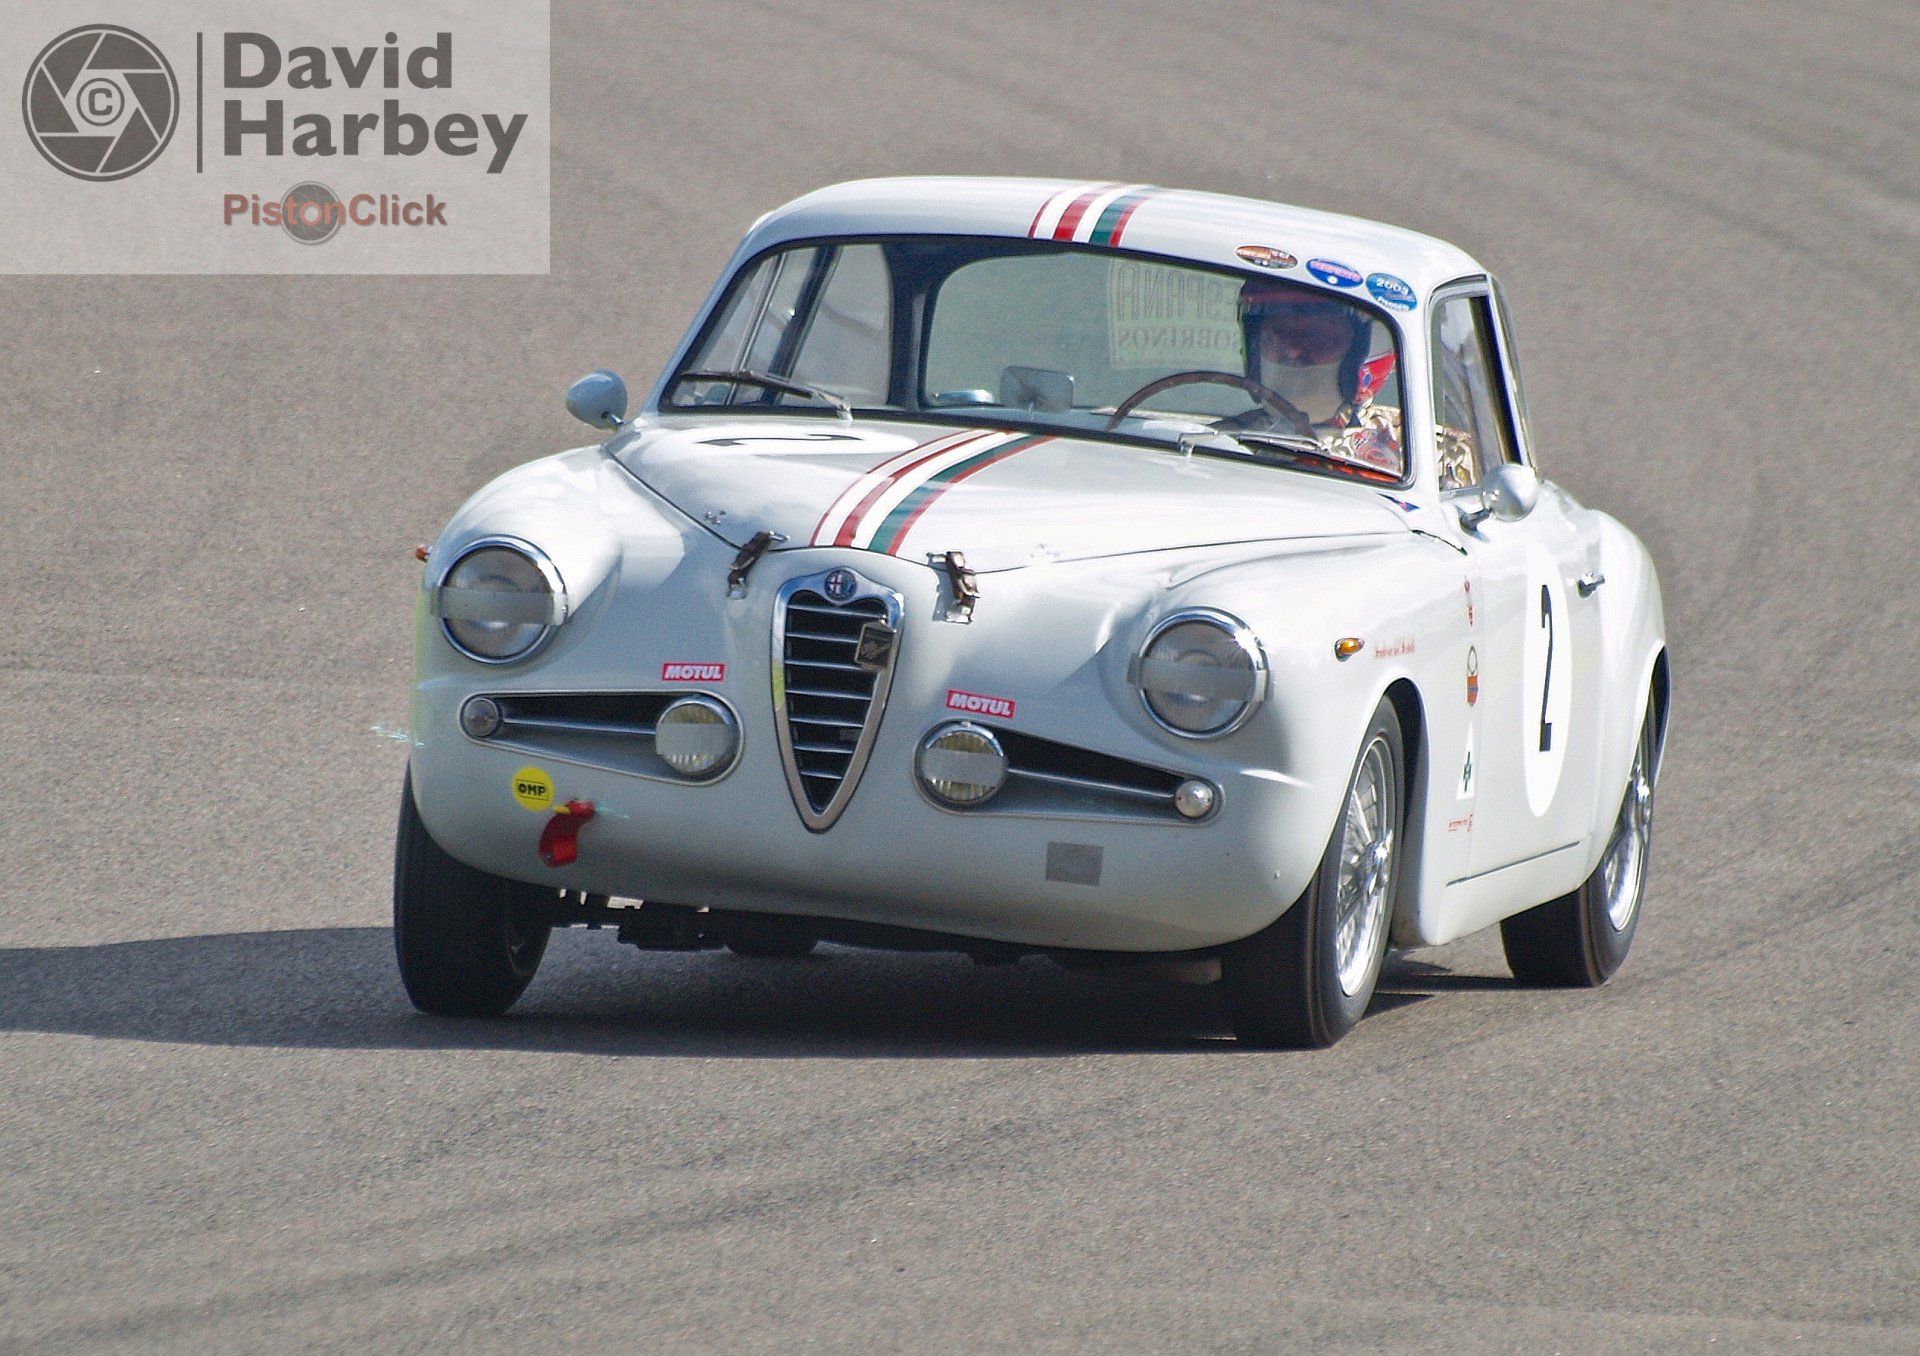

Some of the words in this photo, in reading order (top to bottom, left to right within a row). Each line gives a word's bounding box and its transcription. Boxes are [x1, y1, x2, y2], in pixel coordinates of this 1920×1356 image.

[663, 664, 722, 680] MOTUL
[1538, 583, 1554, 753] 2
[948, 693, 1012, 717] MOTUL
[517, 782, 547, 797] OMP
